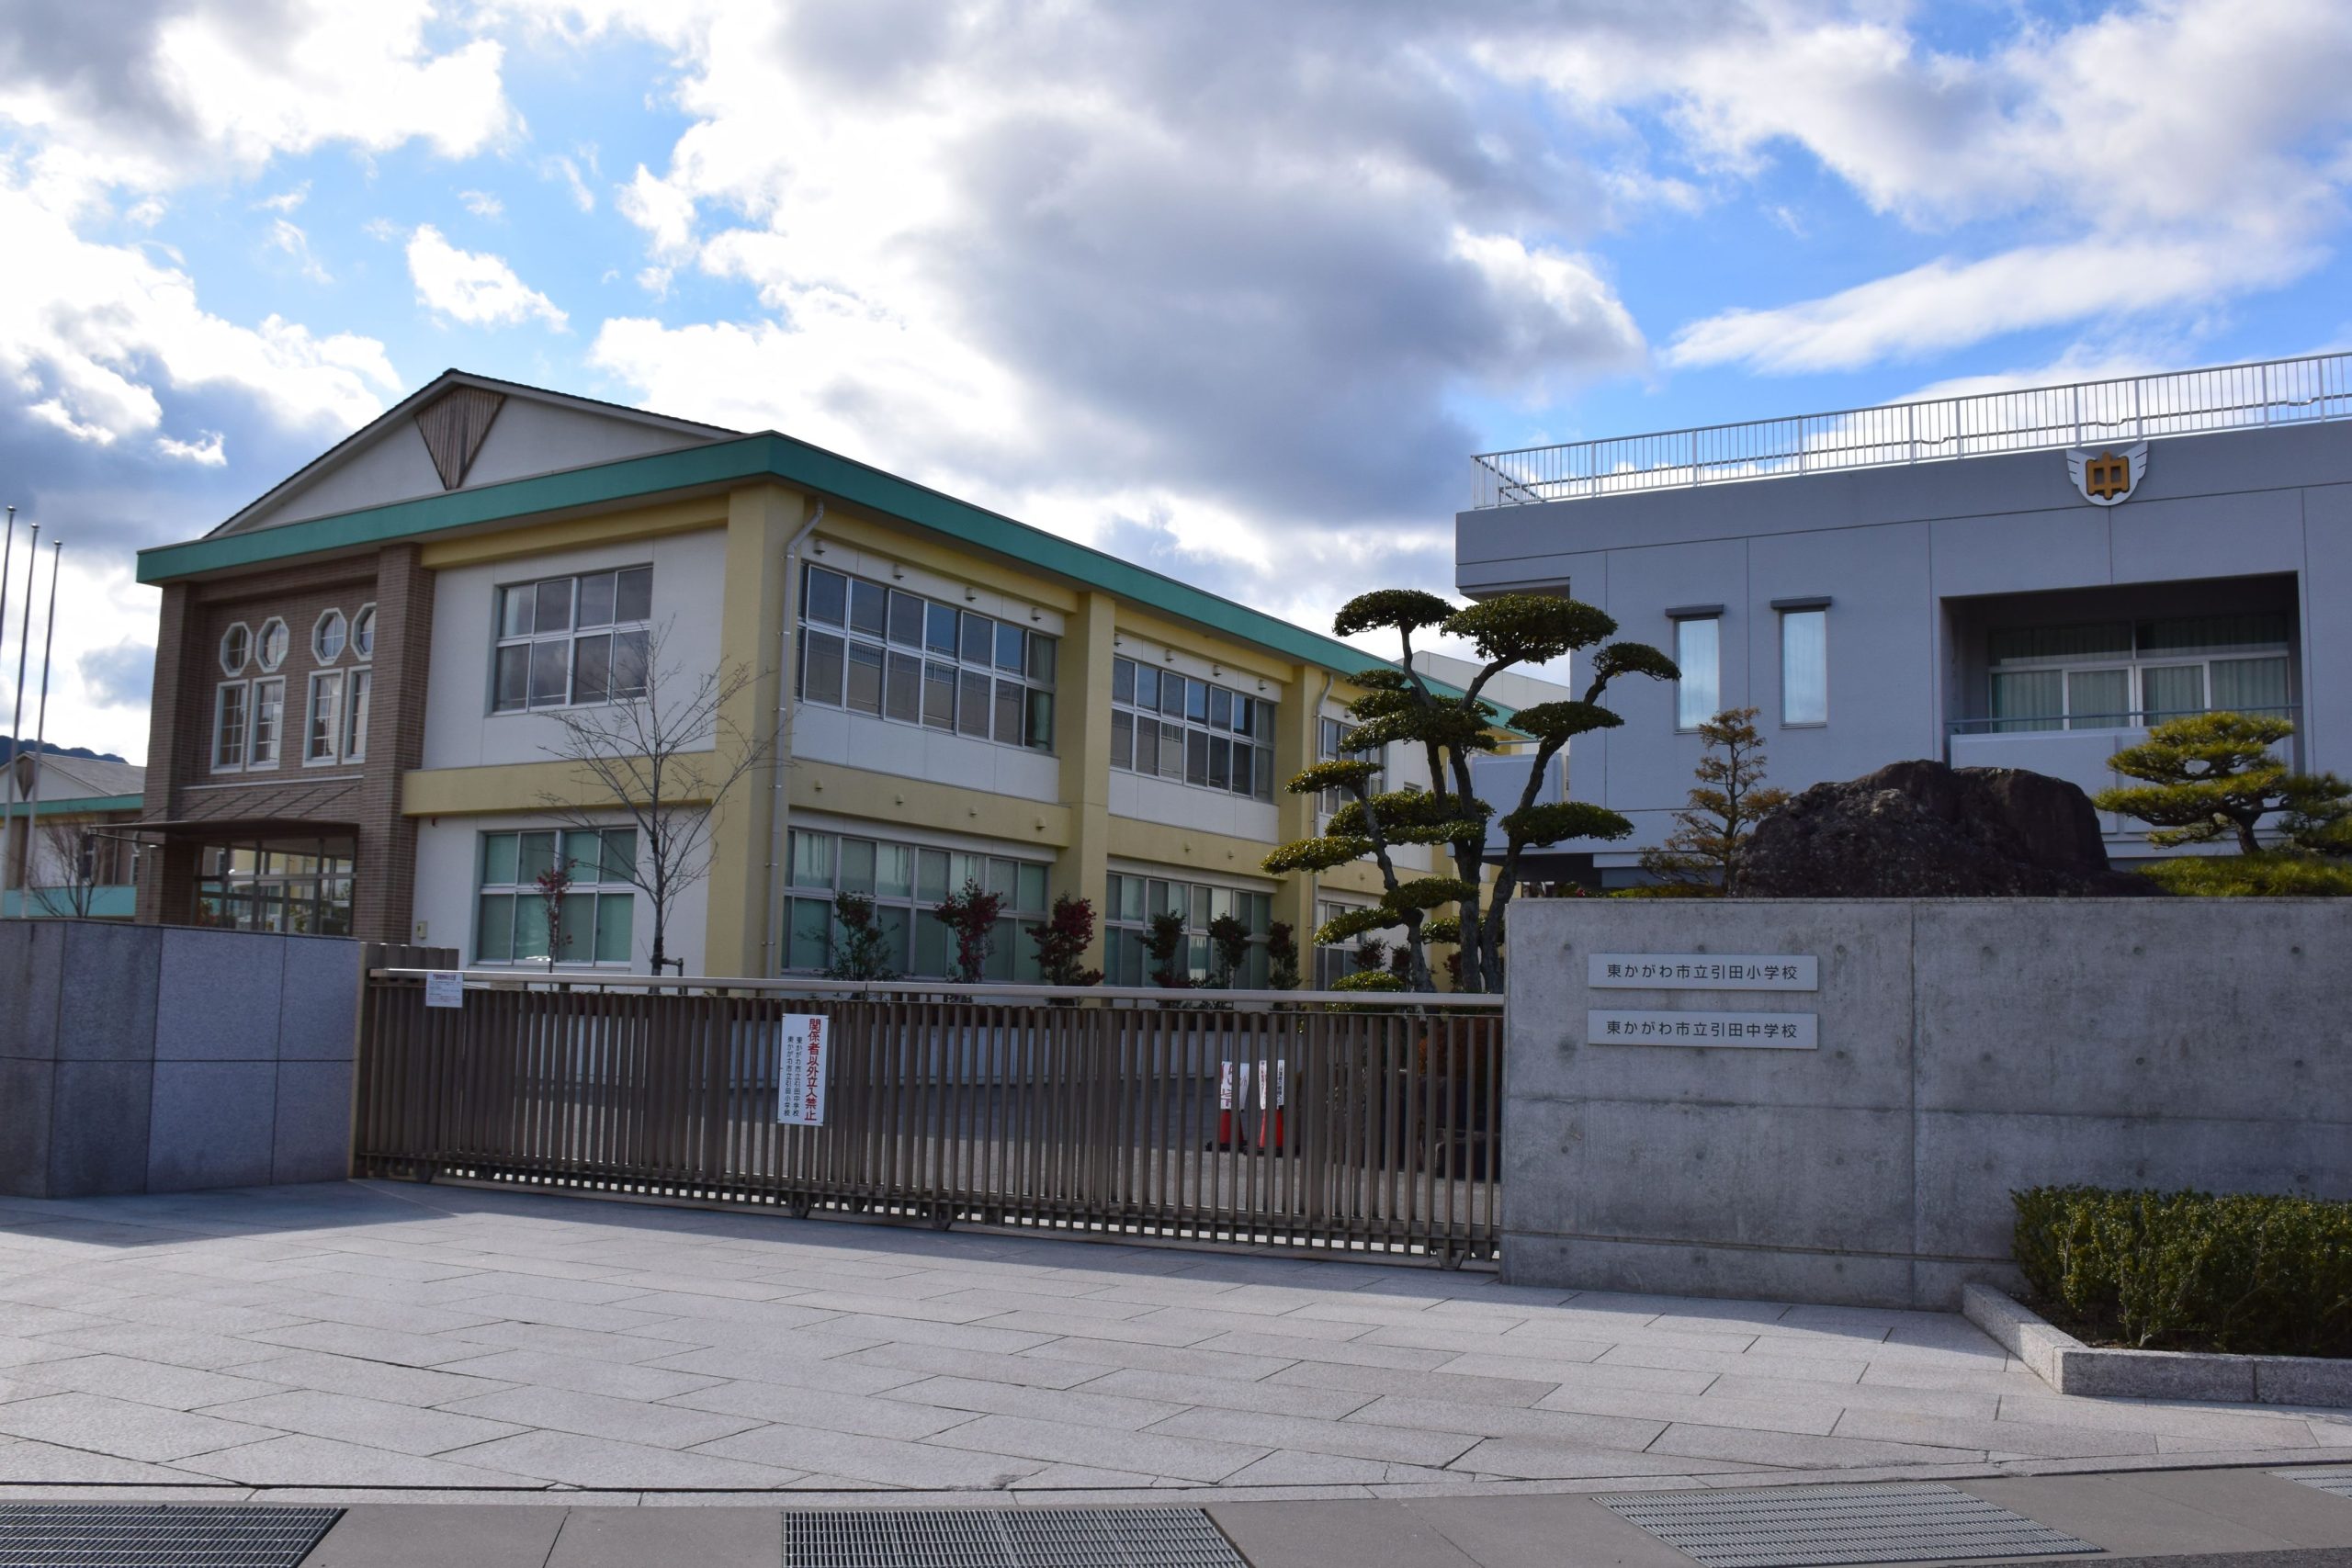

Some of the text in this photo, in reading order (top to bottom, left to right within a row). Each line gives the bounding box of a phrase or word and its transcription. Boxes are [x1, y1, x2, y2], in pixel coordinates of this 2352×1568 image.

[1607, 964, 1798, 980] 東かがわ市立引田小学校
[804, 1018, 821, 1121] 関係者以外立入禁止
[1606, 1020, 1798, 1038] 東かがわ市立引田中学校
[784, 1035, 794, 1117] 東かがわ市立引田小学校
[792, 1035, 803, 1117] 東かがわ市立引田中学校
